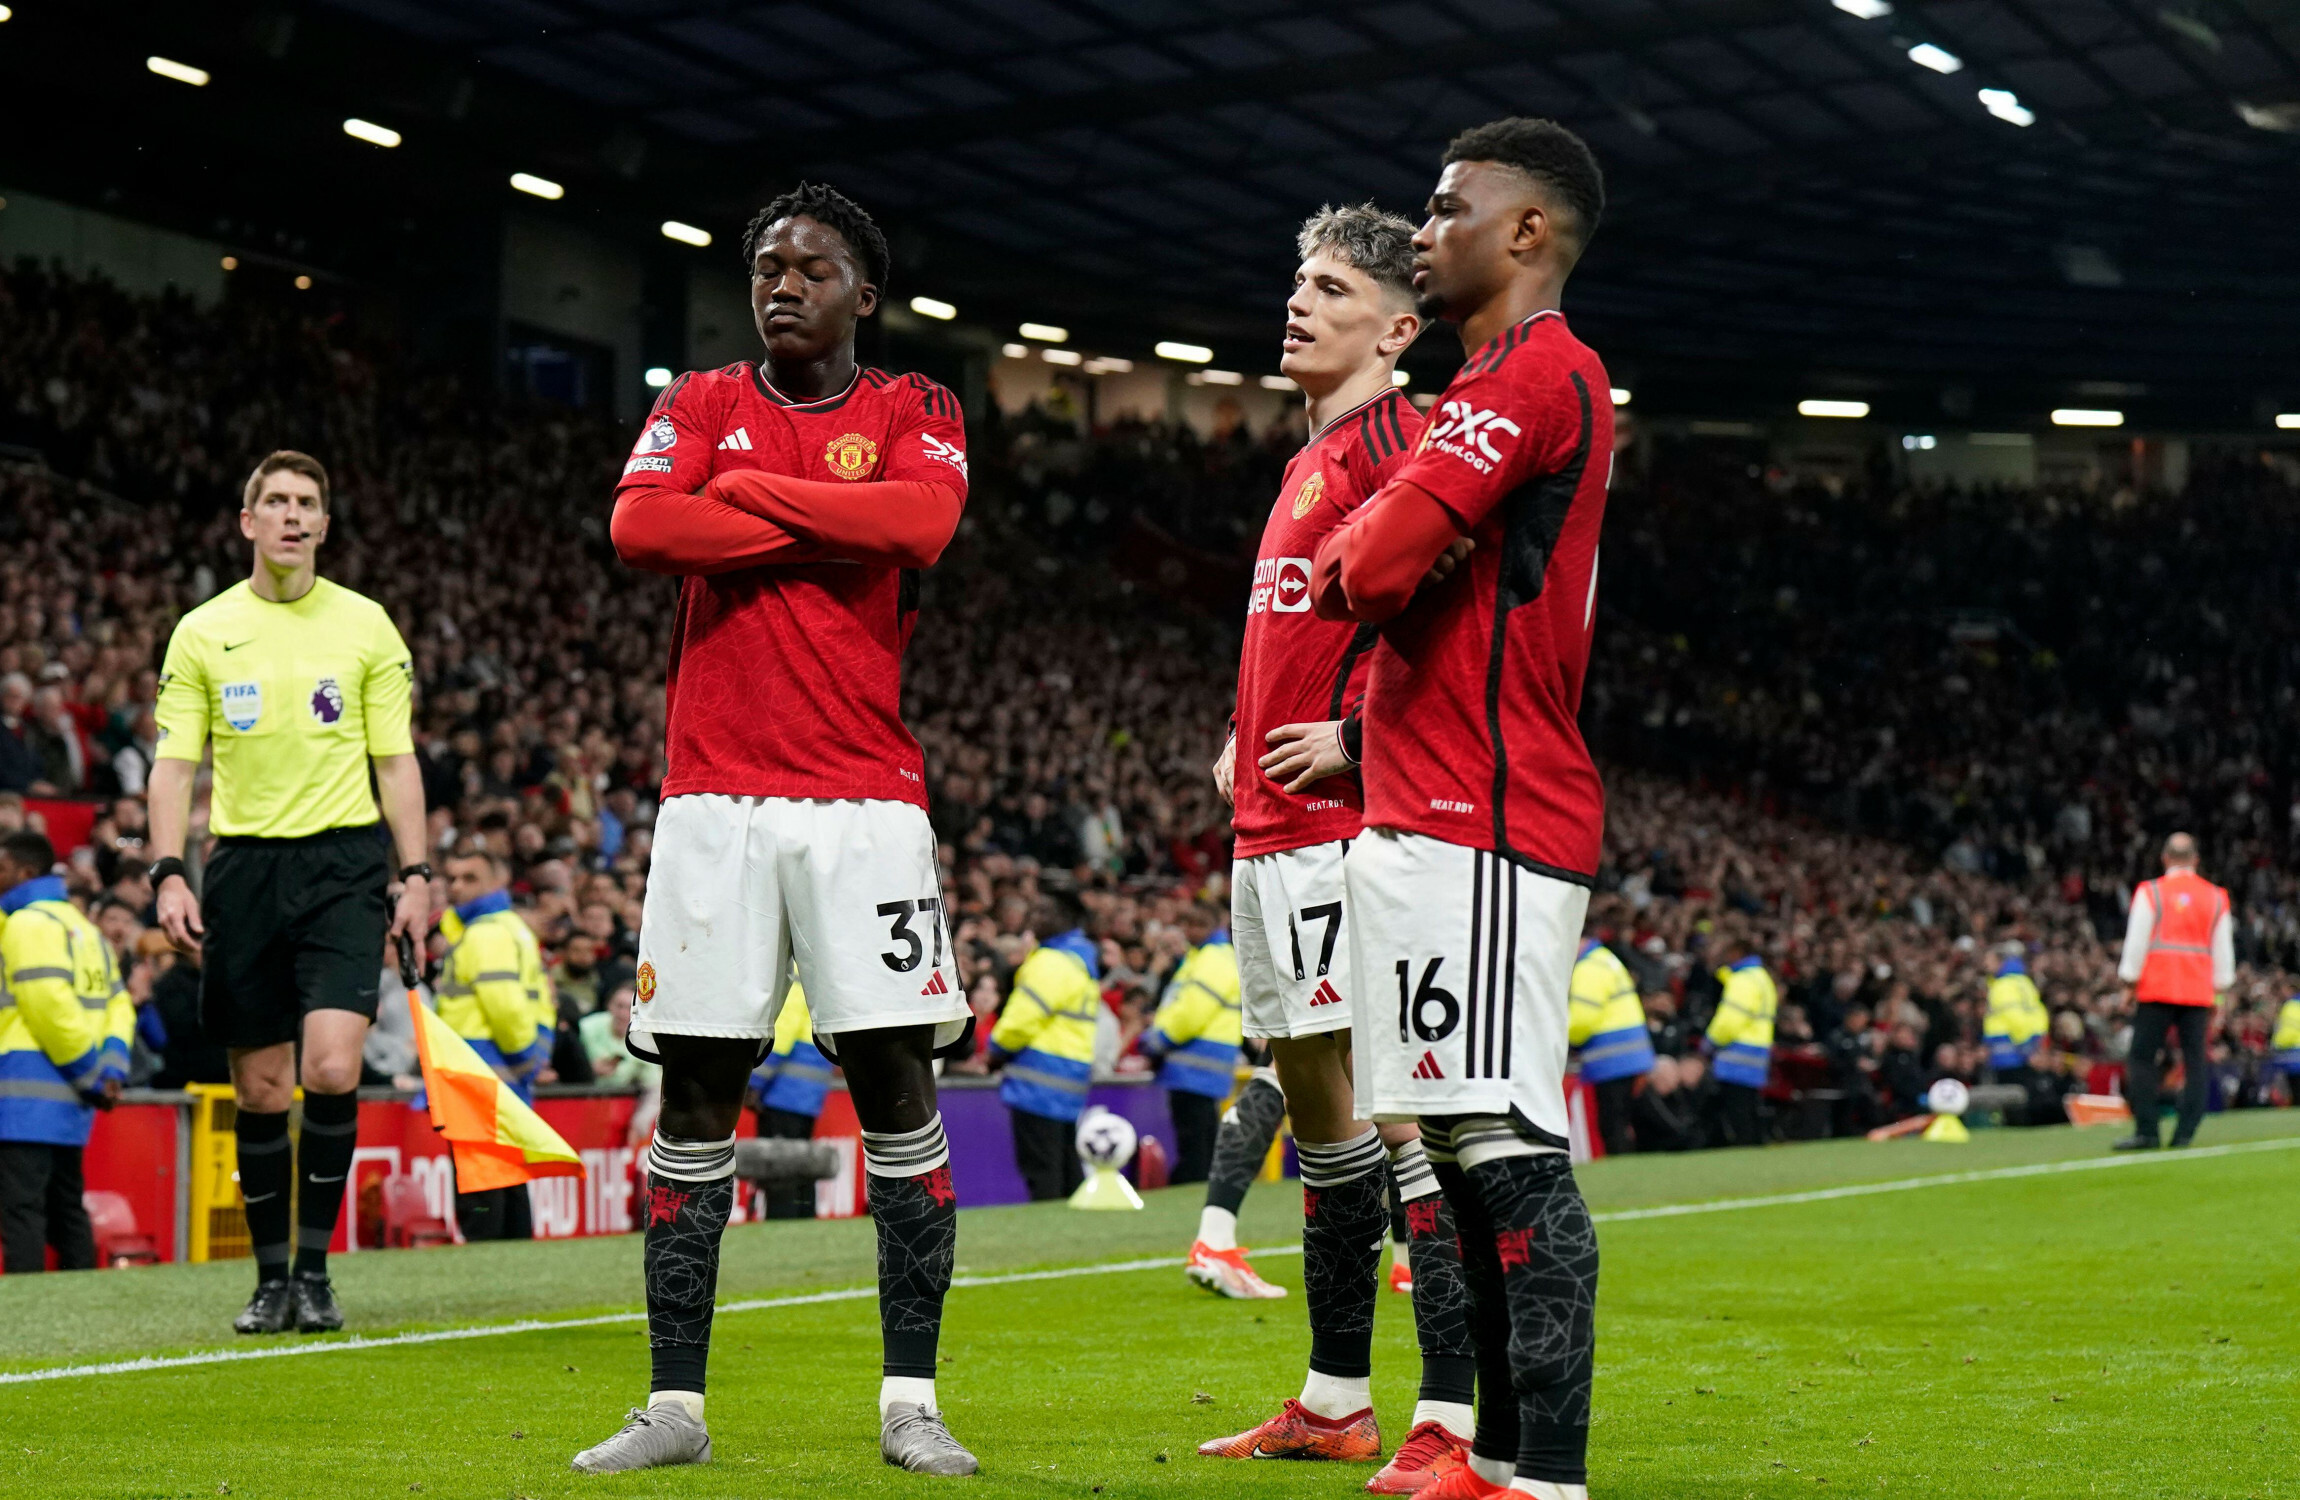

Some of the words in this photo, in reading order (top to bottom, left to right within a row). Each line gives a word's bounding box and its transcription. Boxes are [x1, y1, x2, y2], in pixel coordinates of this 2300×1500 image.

[831, 436, 873, 451] MANCHESTER
[836, 467, 866, 477] UNITED
[224, 685, 257, 698] FIFA
[1306, 799, 1344, 812] HEAT.RDY
[1430, 798, 1475, 814] HEAT.RDY
[876, 897, 942, 973] 37
[1288, 900, 1343, 982] 17
[1395, 956, 1460, 1044] 16
